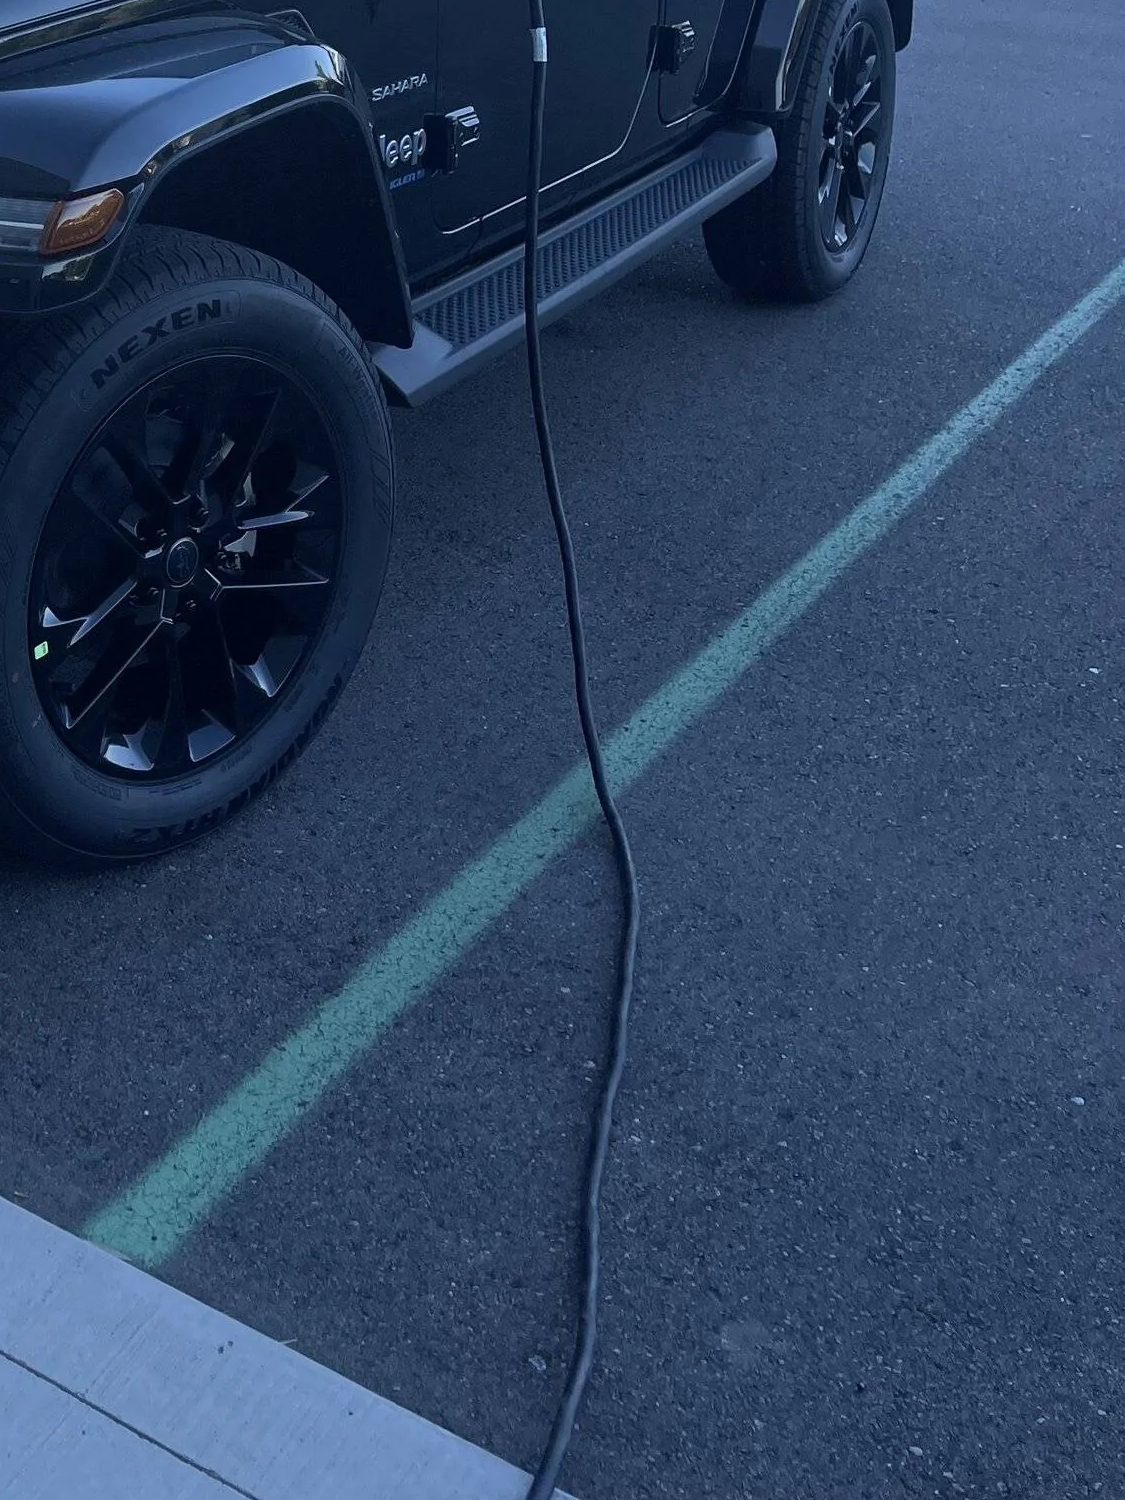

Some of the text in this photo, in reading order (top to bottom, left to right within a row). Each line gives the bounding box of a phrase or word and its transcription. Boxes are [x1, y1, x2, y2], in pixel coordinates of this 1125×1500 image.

[371, 73, 429, 102] SAHARA
[378, 128, 427, 168] Jeep
[90, 299, 222, 390] NEXEN
